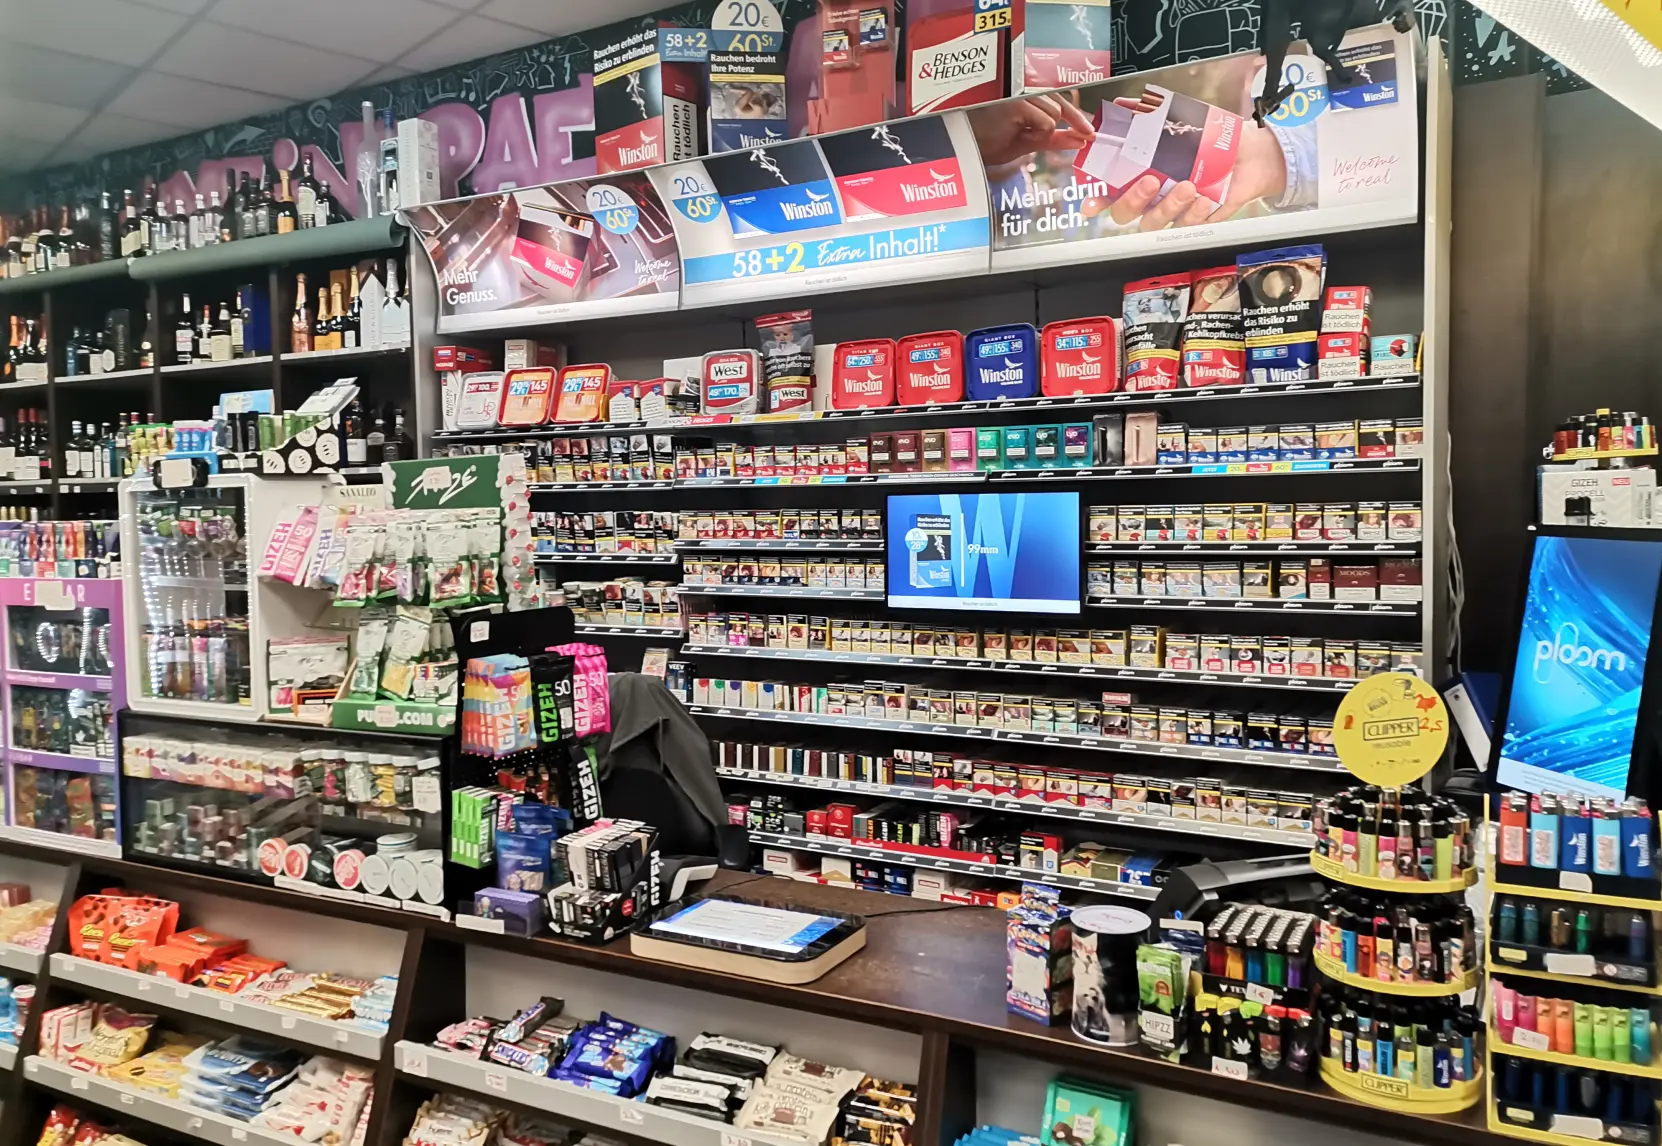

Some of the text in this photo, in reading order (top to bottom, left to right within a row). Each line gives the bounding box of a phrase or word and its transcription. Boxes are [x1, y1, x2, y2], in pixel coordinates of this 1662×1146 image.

[727, 1, 761, 27] 20
[593, 28, 657, 60] Rauchen erhöht das
[594, 43, 655, 73] Risiko zu erblinden
[710, 53, 777, 64] Rauchen bedroht
[933, 45, 989, 67] BENSON
[711, 63, 755, 73] Ihre Potenz
[918, 59, 987, 81] & HEDGES
[1056, 65, 1104, 84] Winston
[1308, 89, 1326, 101] St.
[1363, 89, 1395, 103] Winston
[672, 103, 680, 161] Rauchen
[740, 133, 782, 149] Winston
[1214, 115, 1237, 152] Winston
[618, 141, 658, 167] Winston
[673, 176, 699, 195] 20
[900, 178, 958, 204] Winston
[1000, 175, 1108, 213] Mehr drin
[592, 190, 617, 208] 20
[686, 197, 711, 219] 60
[605, 210, 629, 230] 60
[779, 200, 834, 222] Winston
[1000, 212, 1033, 240] für
[816, 240, 867, 268] Extra
[544, 256, 576, 280] Winston
[443, 269, 479, 286] Mehr
[446, 288, 498, 306] Genuss.
[1208, 312, 1242, 321] verursac
[1243, 300, 1310, 317] Rauchen erhöht
[1324, 313, 1360, 321] Rauchen
[1244, 315, 1298, 327] das Risiko zu
[1188, 330, 1245, 340] Kehlkopfkrebs
[1245, 326, 1284, 337] erblinden
[713, 364, 745, 377] West
[1055, 362, 1101, 379] Winston
[1194, 364, 1241, 380] Winston
[1320, 360, 1357, 369] Rauchen
[583, 376, 602, 388] 145
[909, 372, 951, 389] Winston
[979, 368, 1023, 384] Winston
[1136, 374, 1171, 390] Winston
[1269, 367, 1301, 382] Winst
[530, 379, 549, 392] 145
[780, 388, 806, 398] West
[844, 378, 884, 394] Winston
[967, 543, 999, 555] 99mm
[1533, 622, 1627, 684] ploom
[554, 679, 572, 697] 50
[573, 673, 592, 733] GIZEH
[495, 687, 516, 751] GIZEH
[537, 682, 559, 744] GIZEH
[1367, 721, 1414, 737] CLIPPER
[576, 759, 600, 821] GIZEH
[1573, 833, 1587, 865] Winston
[1637, 833, 1649, 867] Winston
[1364, 1078, 1405, 1094] CLIPPER
